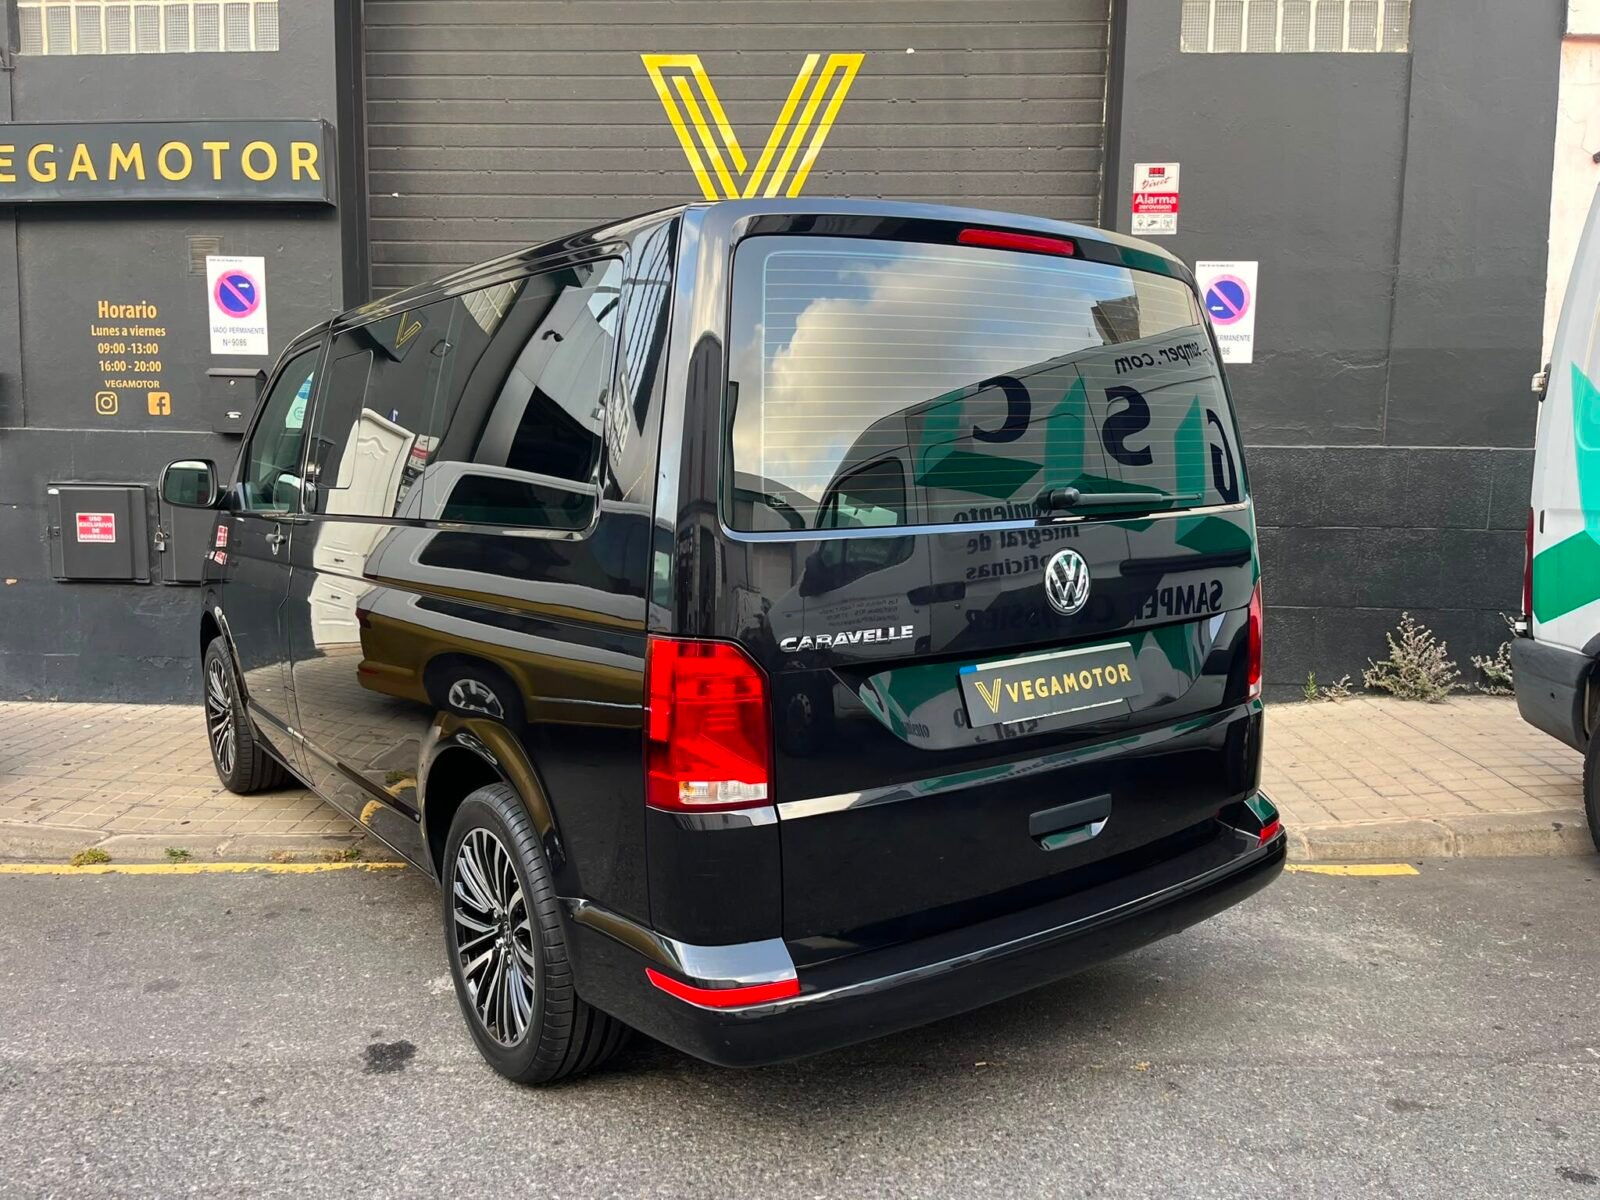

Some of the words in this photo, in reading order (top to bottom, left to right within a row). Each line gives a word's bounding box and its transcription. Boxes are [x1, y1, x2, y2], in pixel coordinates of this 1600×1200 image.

[1135, 194, 1176, 204] Alarma
[97, 300, 157, 319] Horario
[91, 324, 120, 336] Lunes
[121, 327, 128, 336] a
[129, 324, 166, 337] viernes
[212, 326, 228, 334] VADO
[229, 326, 265, 335] PERMANENTE
[1216, 334, 1251, 342] ERMANENTE
[97, 343, 126, 354] 09:00
[98, 360, 127, 372] 16:00
[133, 360, 162, 372] 20:00
[104, 380, 160, 389] VEGAMOTOR
[779, 624, 914, 654] CARAVELLE
[1005, 663, 1131, 703] VEGAMOTOR
